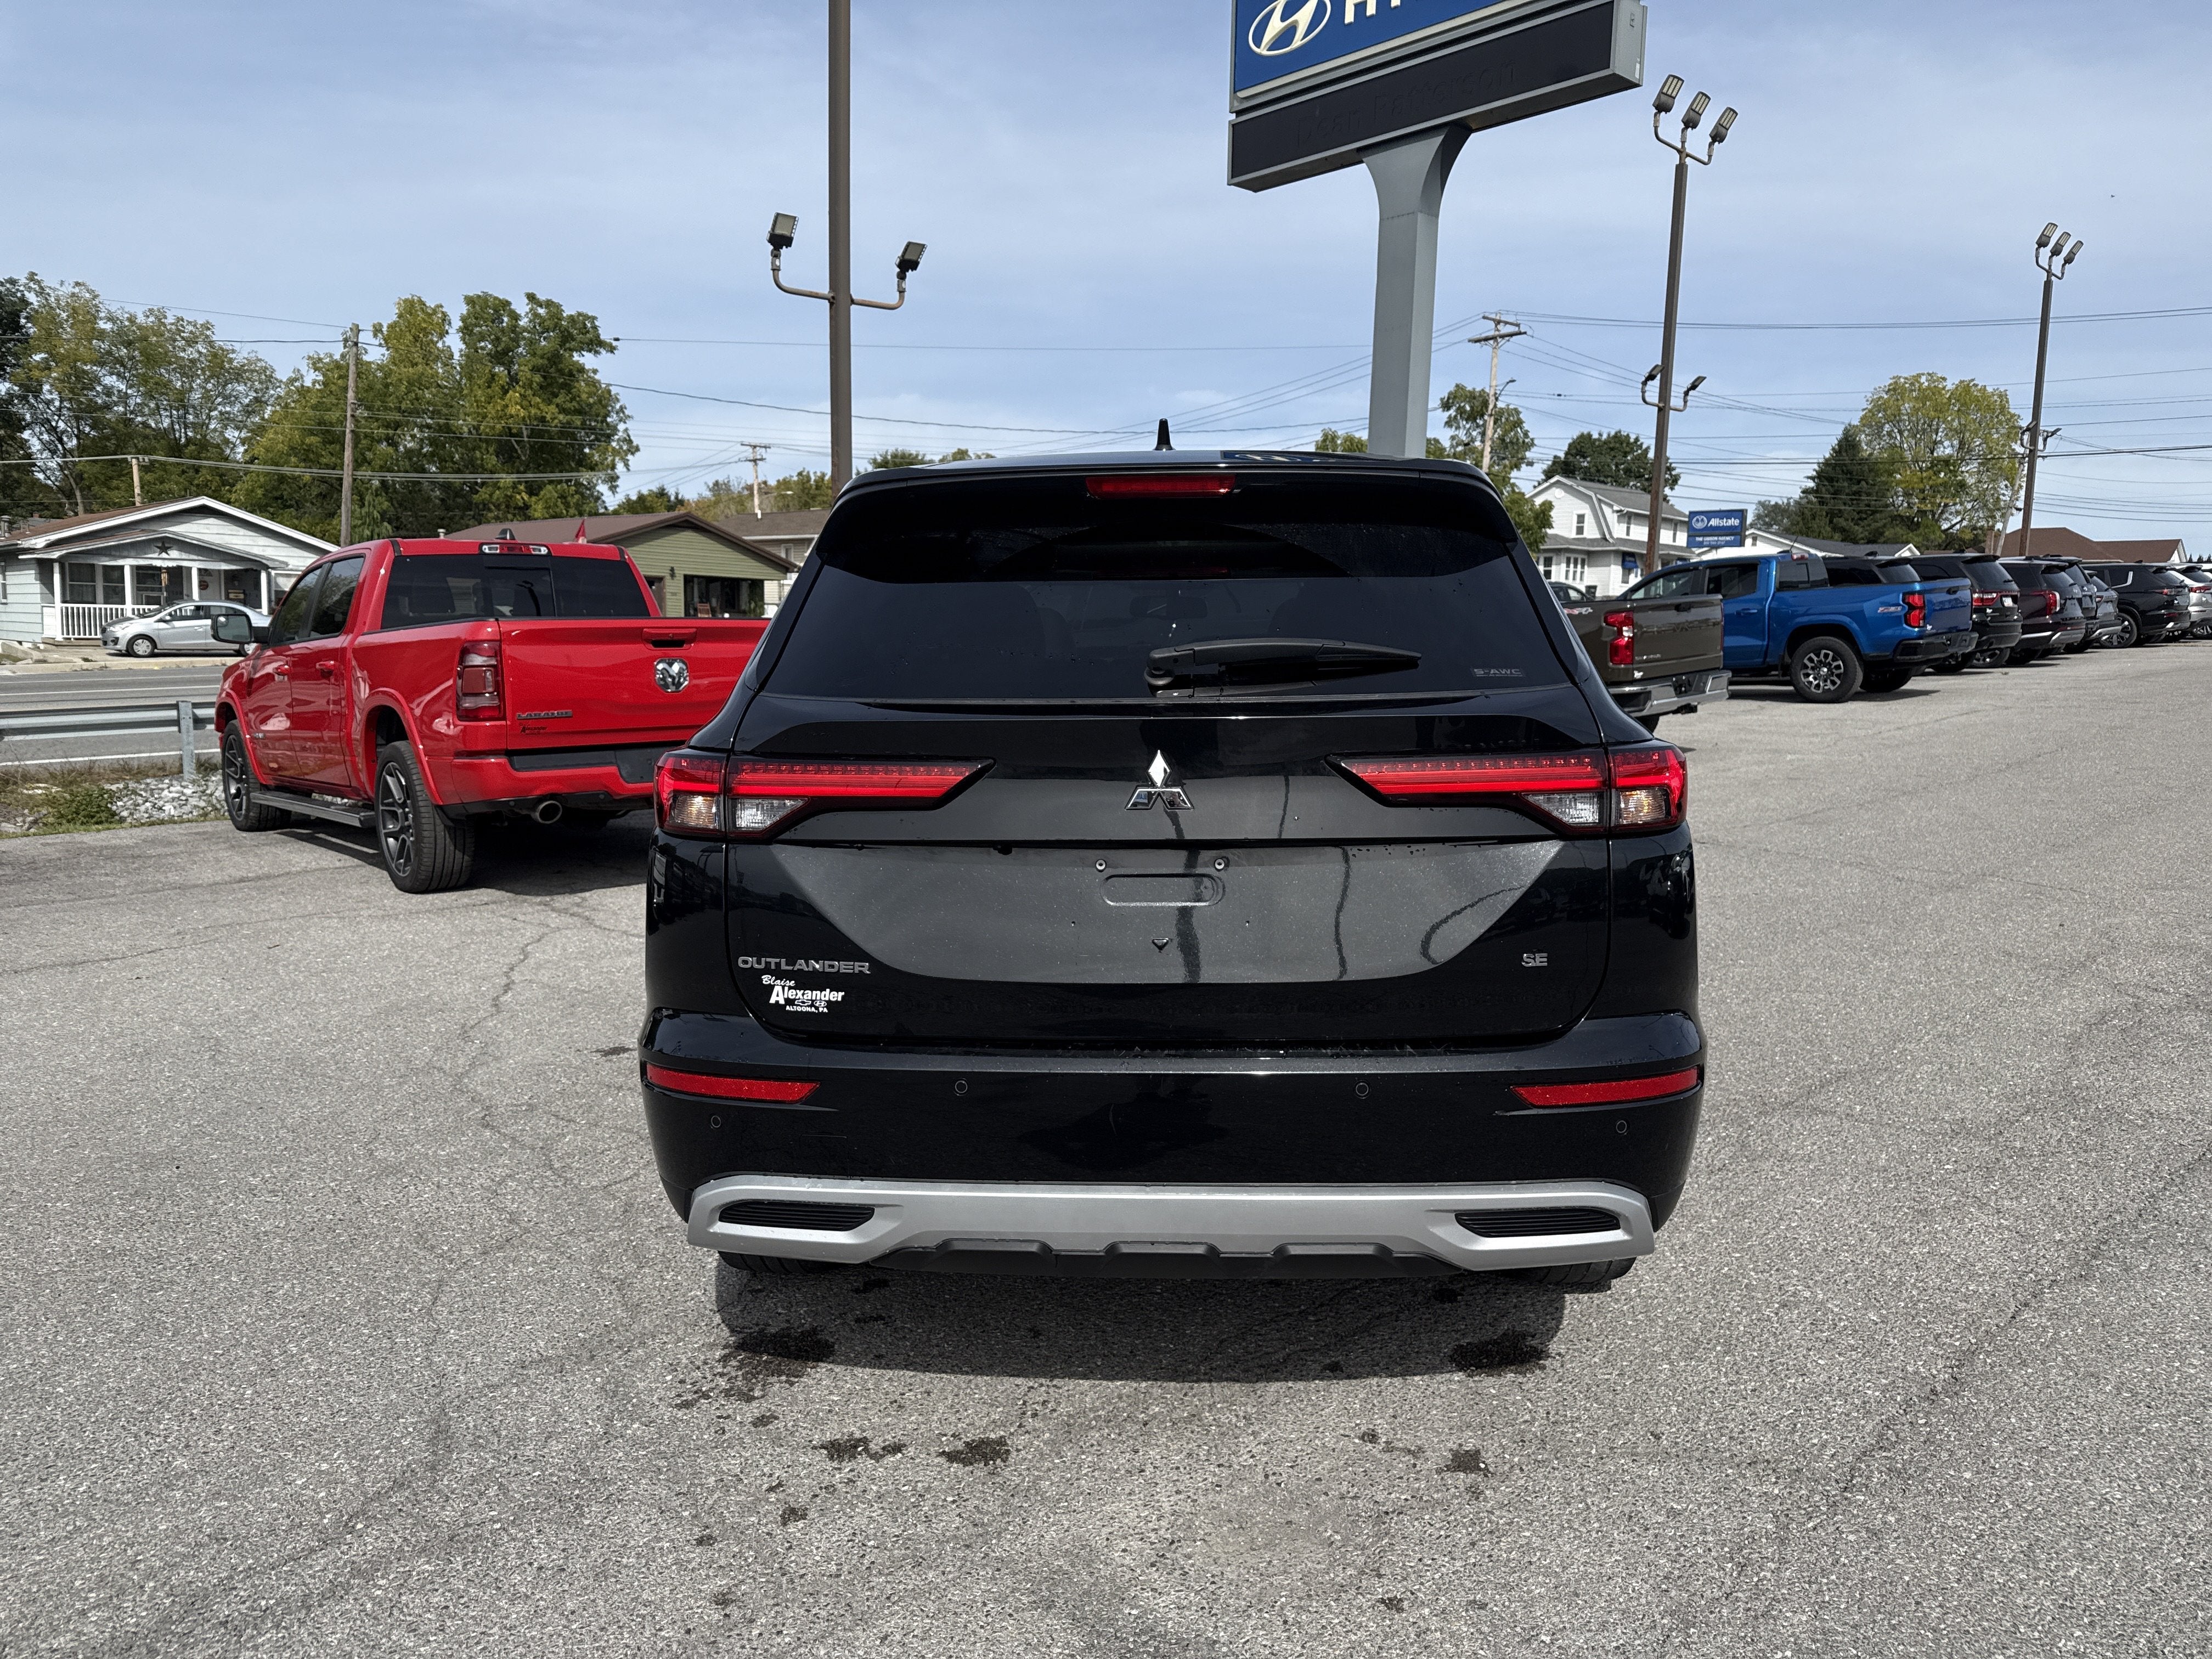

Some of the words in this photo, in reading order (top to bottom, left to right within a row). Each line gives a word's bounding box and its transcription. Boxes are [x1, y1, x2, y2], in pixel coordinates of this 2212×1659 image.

[1708, 517, 1739, 527] Allstate
[738, 957, 871, 974] OUTLANDER
[1521, 953, 1548, 967] SE
[761, 974, 795, 986] Blaise
[769, 985, 845, 1004] Alexander
[786, 1005, 818, 1013] ALTOONA,
